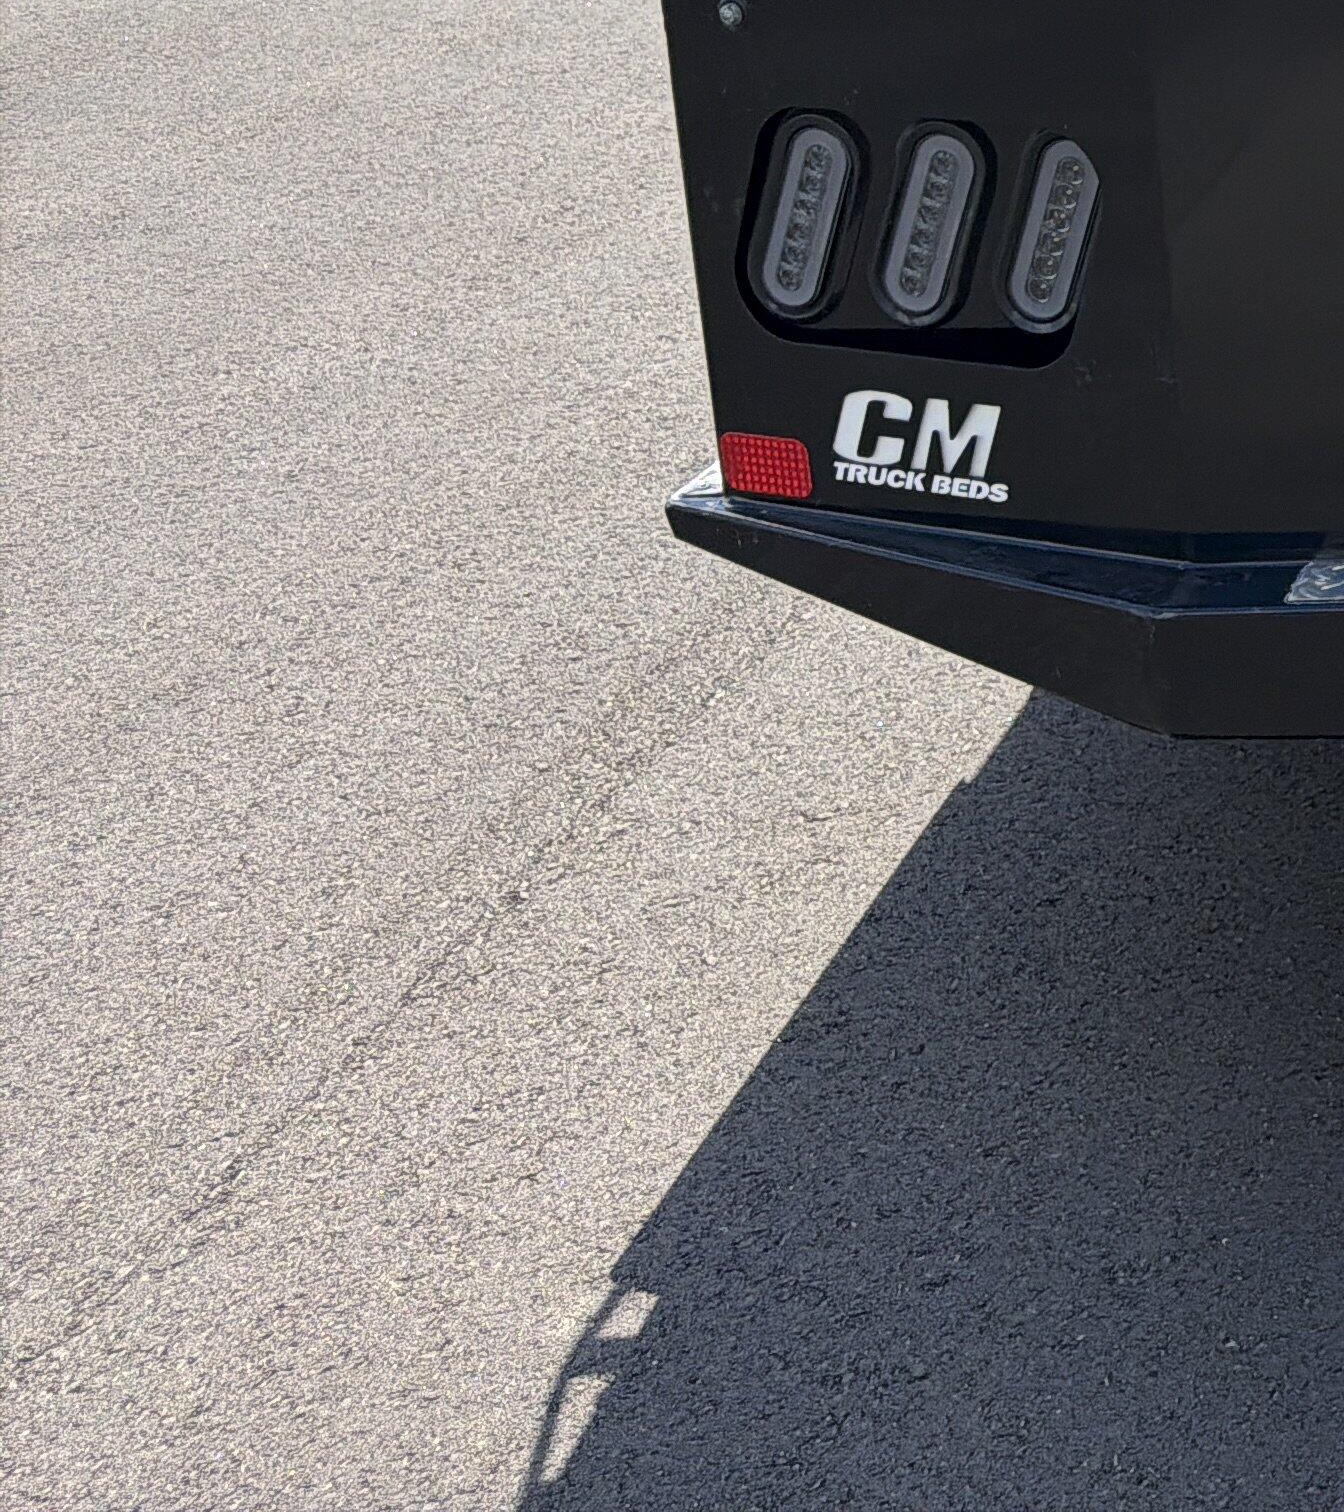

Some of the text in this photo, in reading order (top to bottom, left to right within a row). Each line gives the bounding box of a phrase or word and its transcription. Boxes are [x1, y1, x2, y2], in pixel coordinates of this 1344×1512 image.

[832, 389, 1002, 479] CM
[833, 461, 1010, 503] TRUCK BEDS
